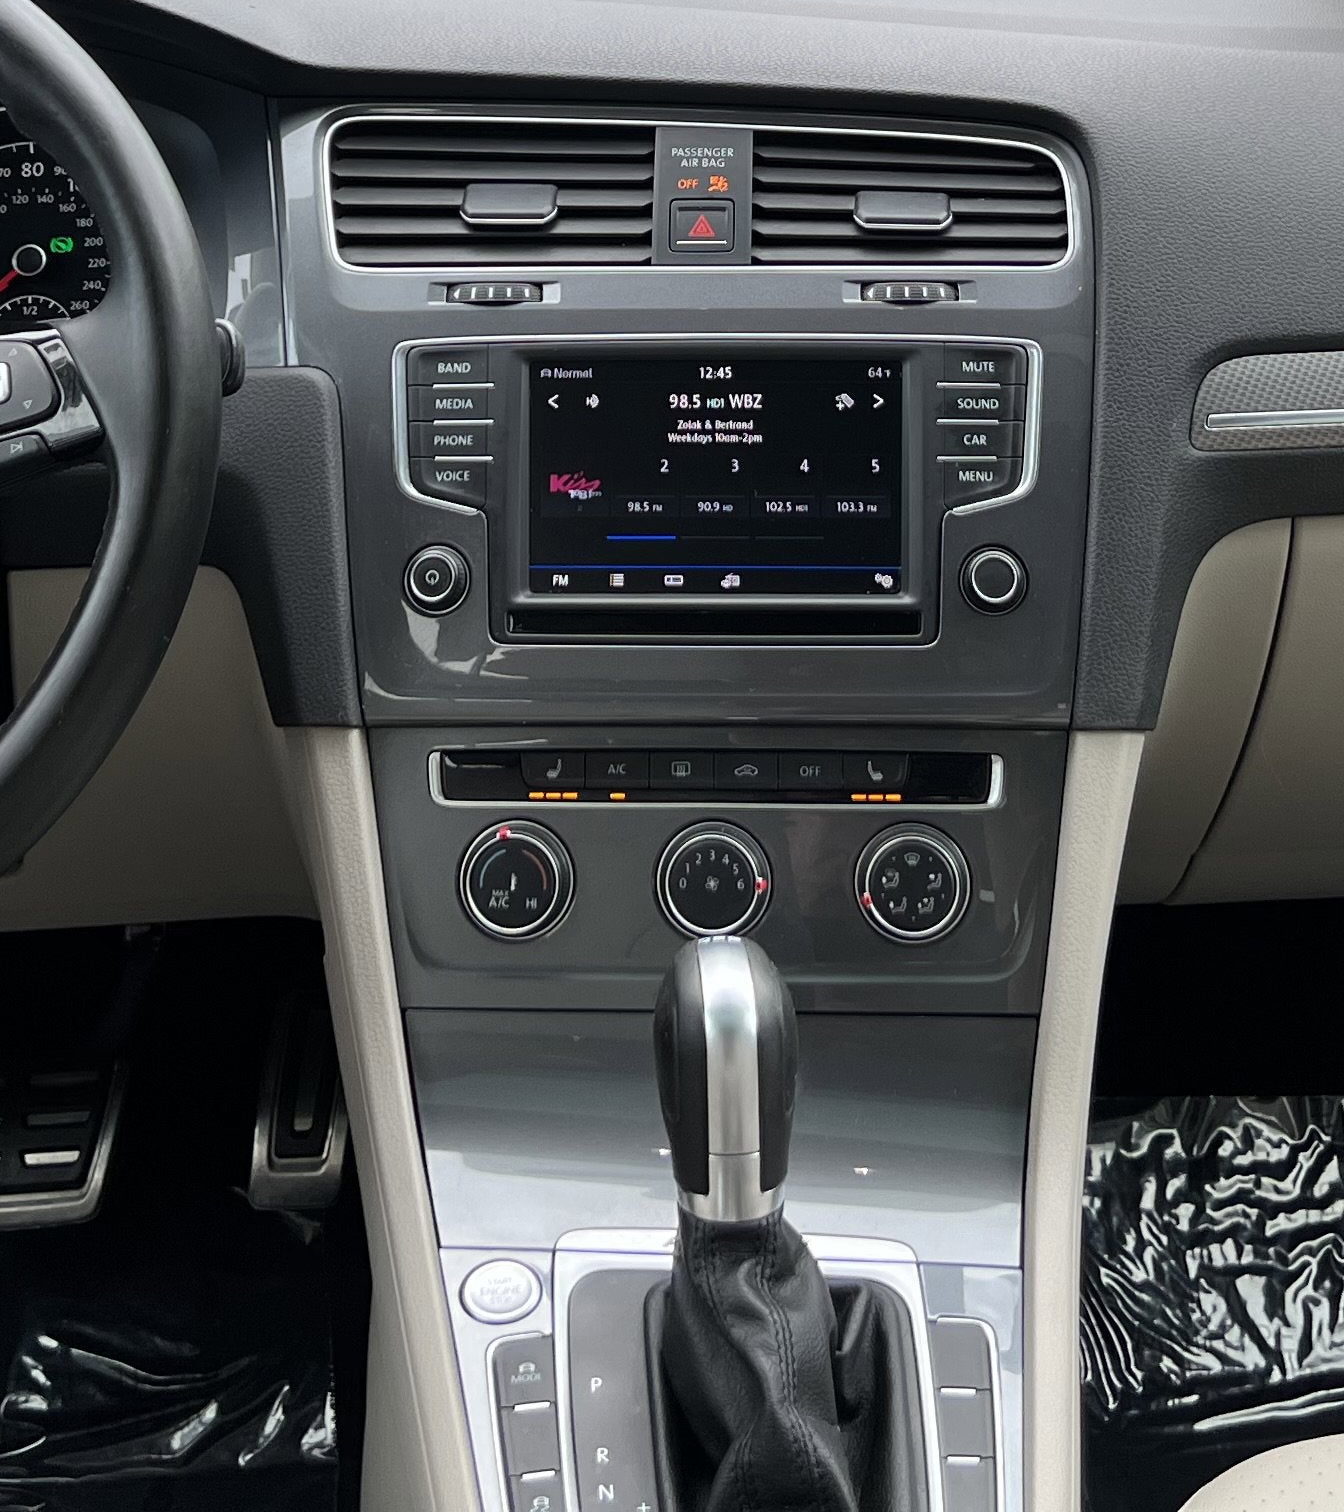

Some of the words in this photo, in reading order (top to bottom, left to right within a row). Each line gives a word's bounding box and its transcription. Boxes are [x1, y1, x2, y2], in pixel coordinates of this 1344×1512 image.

[671, 147, 735, 158] PASSENGER
[21, 161, 45, 177] 80
[680, 158, 699, 168] AIR
[701, 158, 726, 168] BAG
[677, 178, 700, 189] OFF
[12, 194, 29, 204] 120
[37, 194, 54, 204] 140
[58, 203, 77, 213] 160
[76, 218, 94, 227] 180
[83, 237, 104, 247] 200
[87, 258, 106, 268] 220
[82, 280, 102, 290] 240
[22, 305, 38, 316] 1/2
[69, 300, 90, 310] 260
[437, 362, 472, 374] BAND
[698, 366, 733, 379] 12:45
[962, 361, 995, 372] MUTE
[553, 367, 593, 379] Normal
[435, 398, 474, 409] MEDIA
[668, 393, 701, 409] 98.5
[706, 398, 725, 409] HD1
[728, 393, 763, 409] WBZ
[957, 398, 999, 410] SOUND
[677, 419, 702, 430] Zolak
[704, 420, 713, 430] &
[714, 419, 754, 430] Bertrand
[433, 434, 474, 446] PHONE
[667, 432, 713, 444] Weekdays
[714, 432, 763, 444] 10am-2pm
[963, 434, 987, 446] CAR
[659, 458, 670, 473] 2
[731, 458, 740, 473] 3
[799, 458, 810, 473] 4
[871, 458, 881, 473] 5
[435, 470, 471, 482] VOICE
[958, 471, 994, 482] MENU
[627, 501, 650, 512] 98.5
[697, 501, 720, 513] 90.9
[765, 501, 792, 513] 102.5
[836, 501, 864, 513] 103.3
[552, 574, 569, 587] FM
[607, 764, 627, 775] A/C
[799, 765, 822, 777] OFF
[695, 853, 702, 865] 2
[709, 849, 716, 861] 3
[721, 854, 730, 865] 4
[685, 863, 690, 875] 1
[732, 863, 739, 875] 5
[679, 877, 687, 889] 0
[737, 878, 745, 890] 6
[491, 889, 509, 897] MAX
[488, 896, 510, 908] A/C
[525, 897, 538, 909] HI
[590, 1377, 603, 1393] P
[596, 1447, 610, 1464] R
[598, 1484, 615, 1501] N
